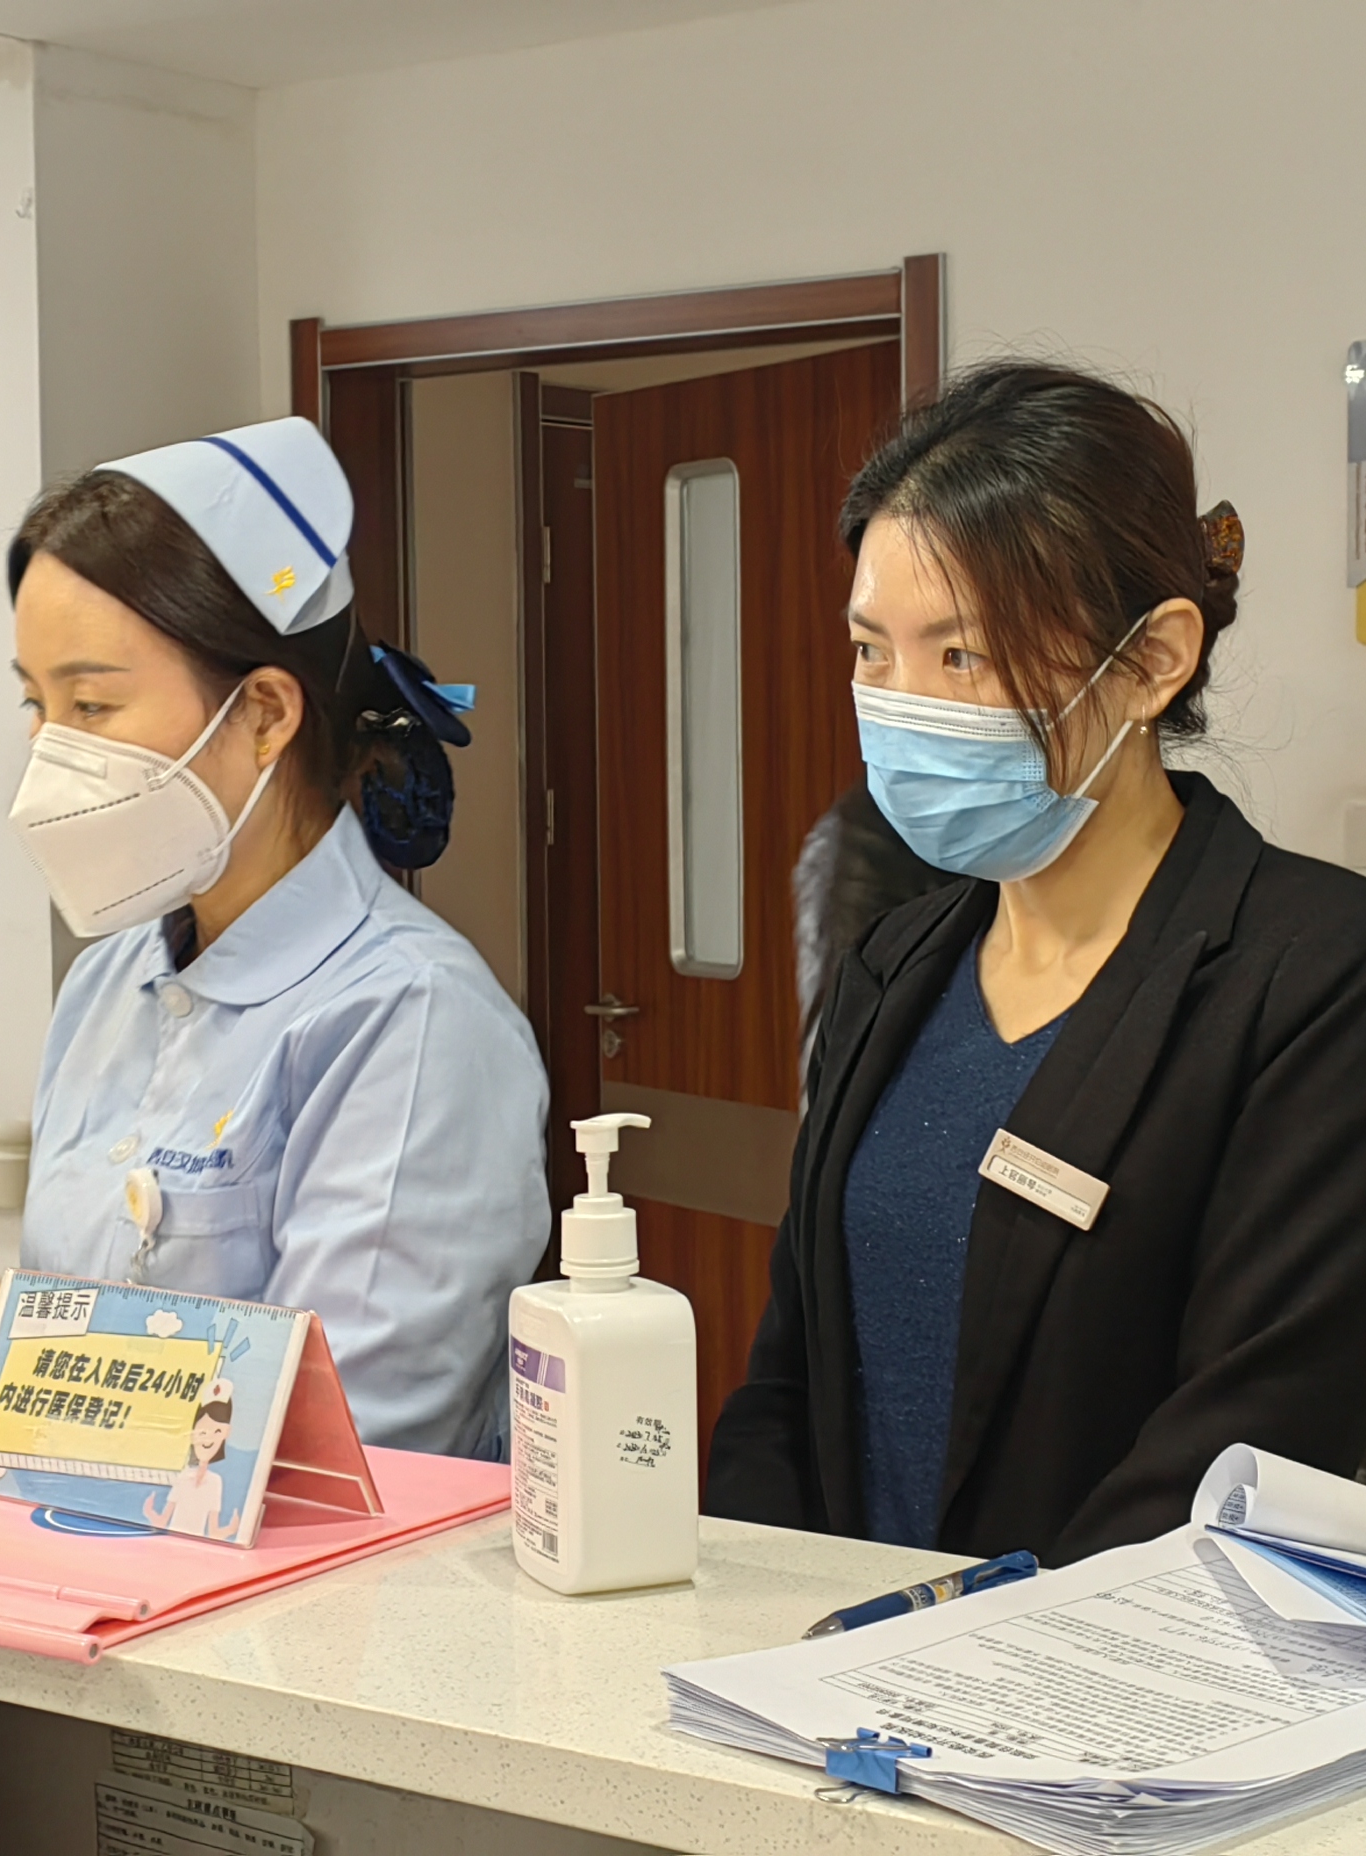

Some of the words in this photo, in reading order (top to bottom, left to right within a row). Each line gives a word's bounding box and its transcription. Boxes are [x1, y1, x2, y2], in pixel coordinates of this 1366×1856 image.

[19, 1292, 90, 1320] 温馨提示
[33, 1348, 205, 1402] 请您在入院后24小时
